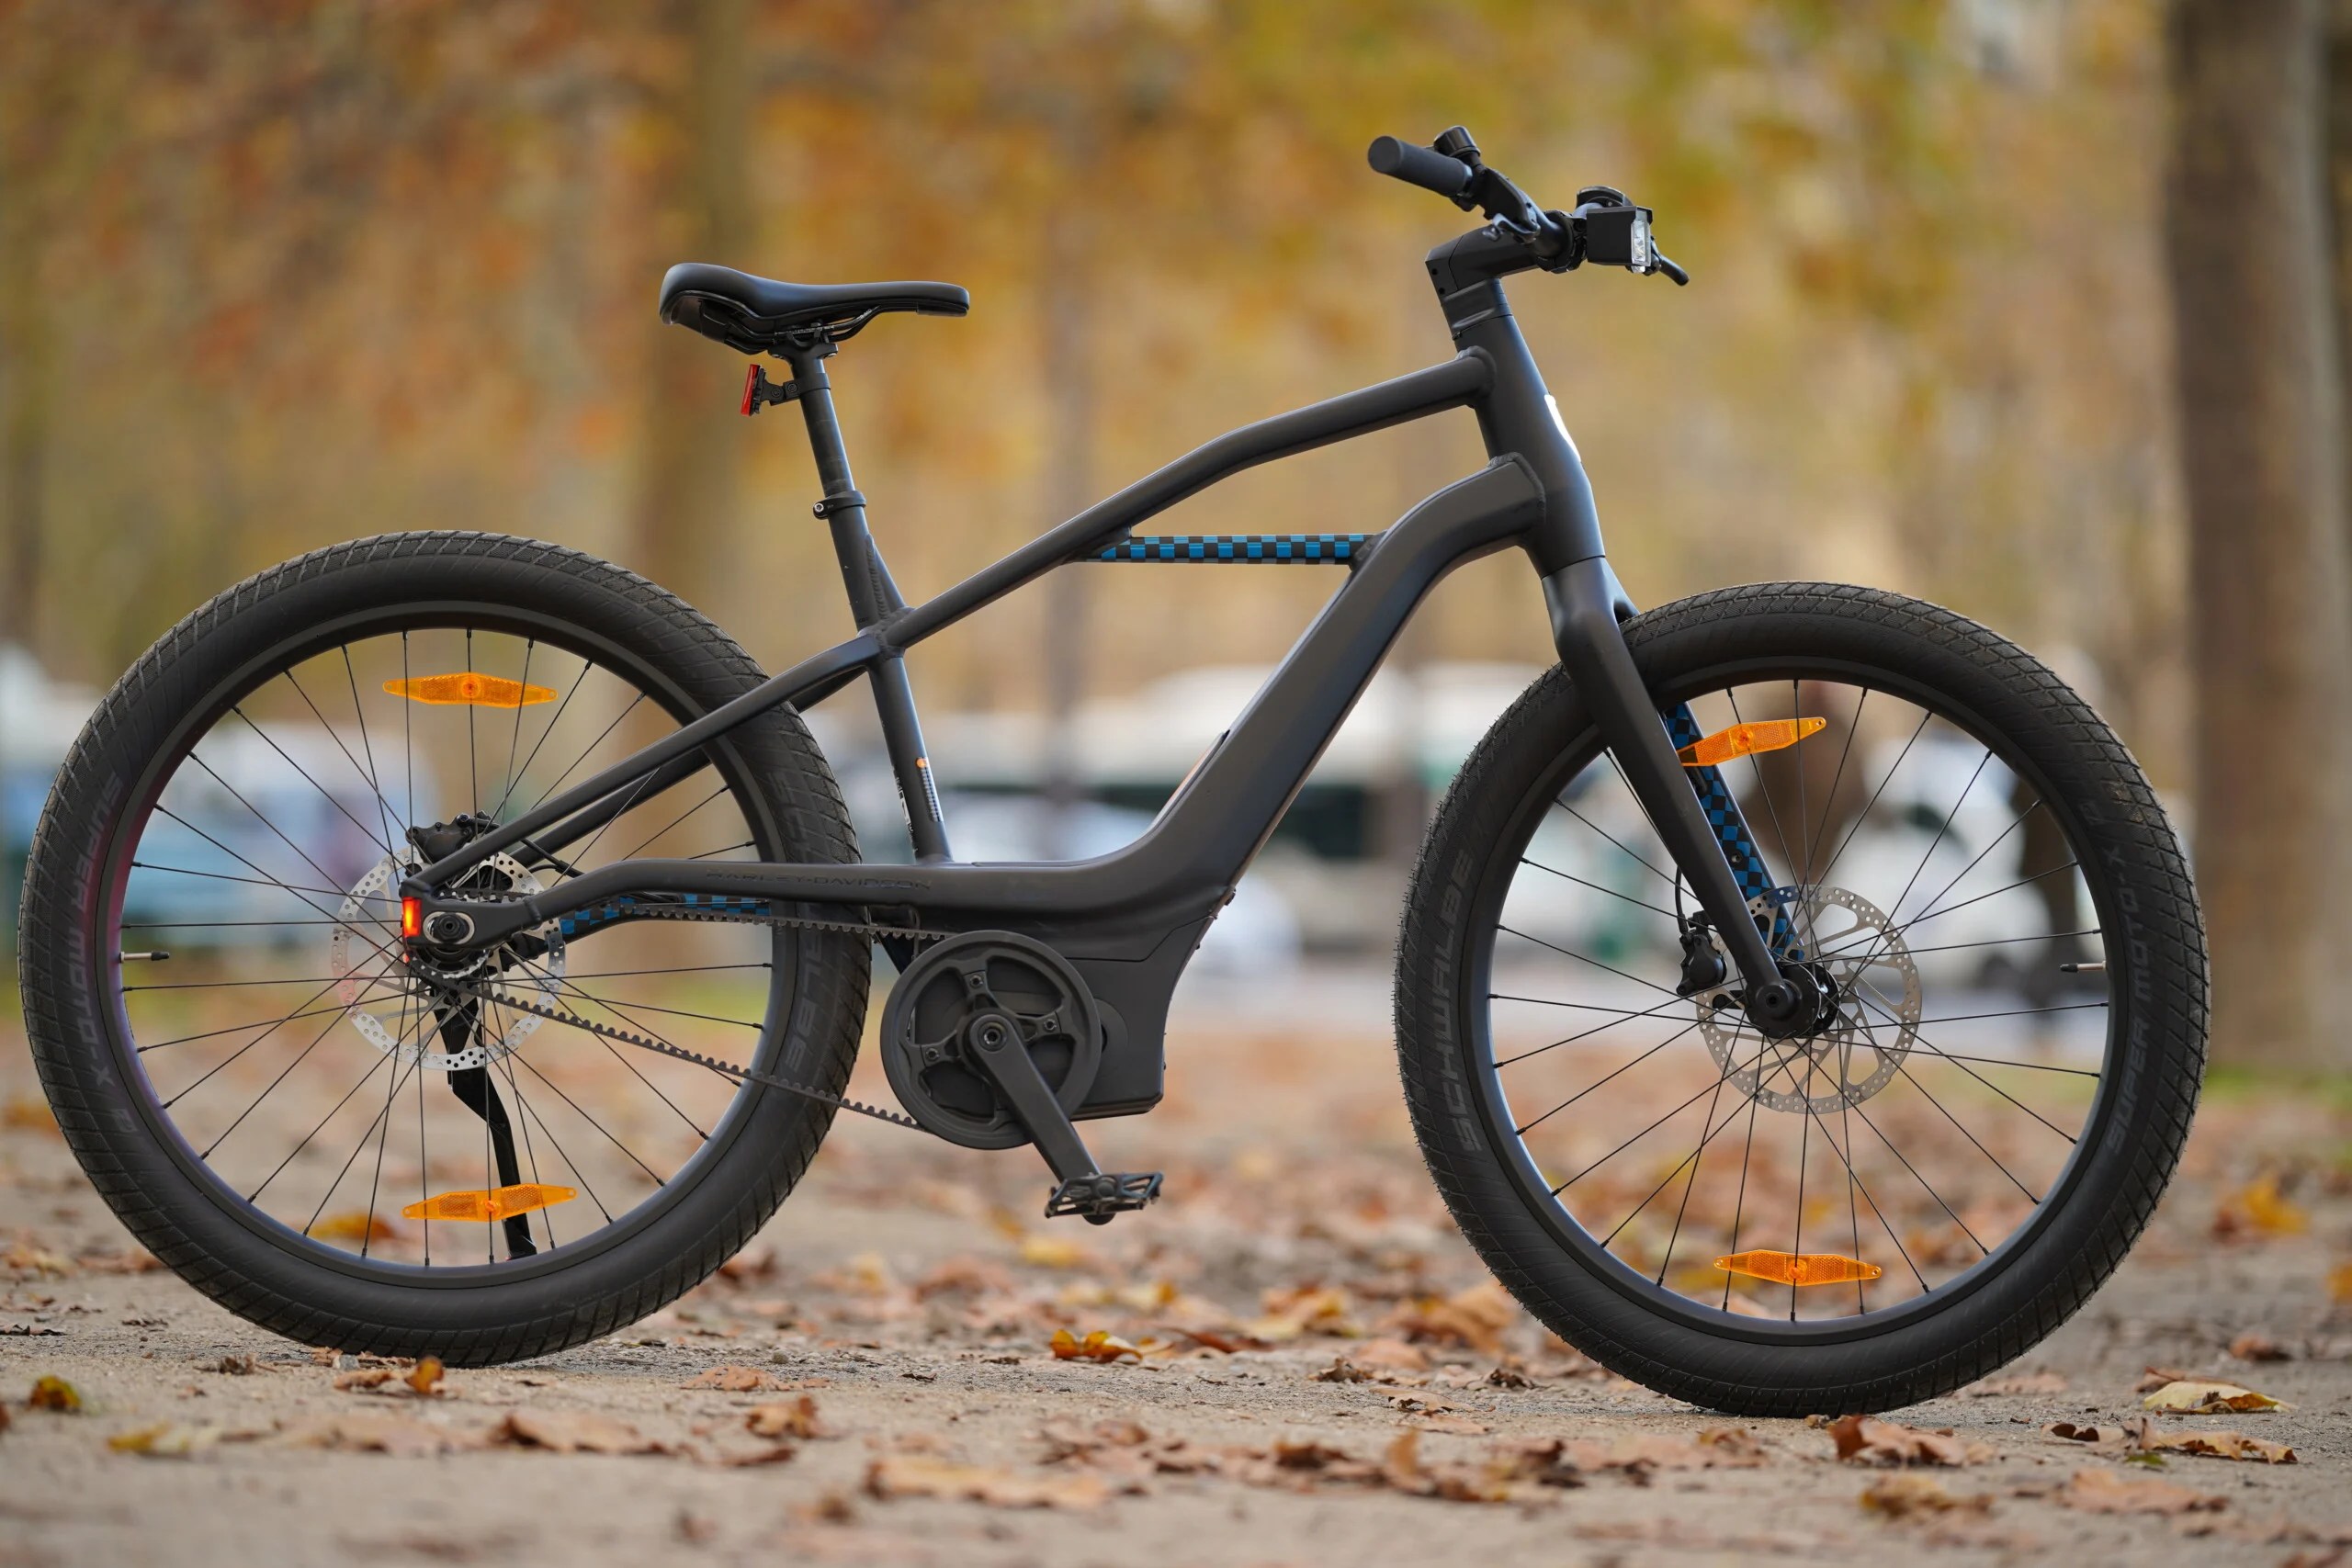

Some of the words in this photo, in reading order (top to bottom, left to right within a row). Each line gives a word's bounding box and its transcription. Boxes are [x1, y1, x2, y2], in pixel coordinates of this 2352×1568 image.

[70, 771, 123, 912] SUPER
[1432, 849, 1481, 1151] SCHWALBE
[2105, 1014, 2150, 1156] SUPER
